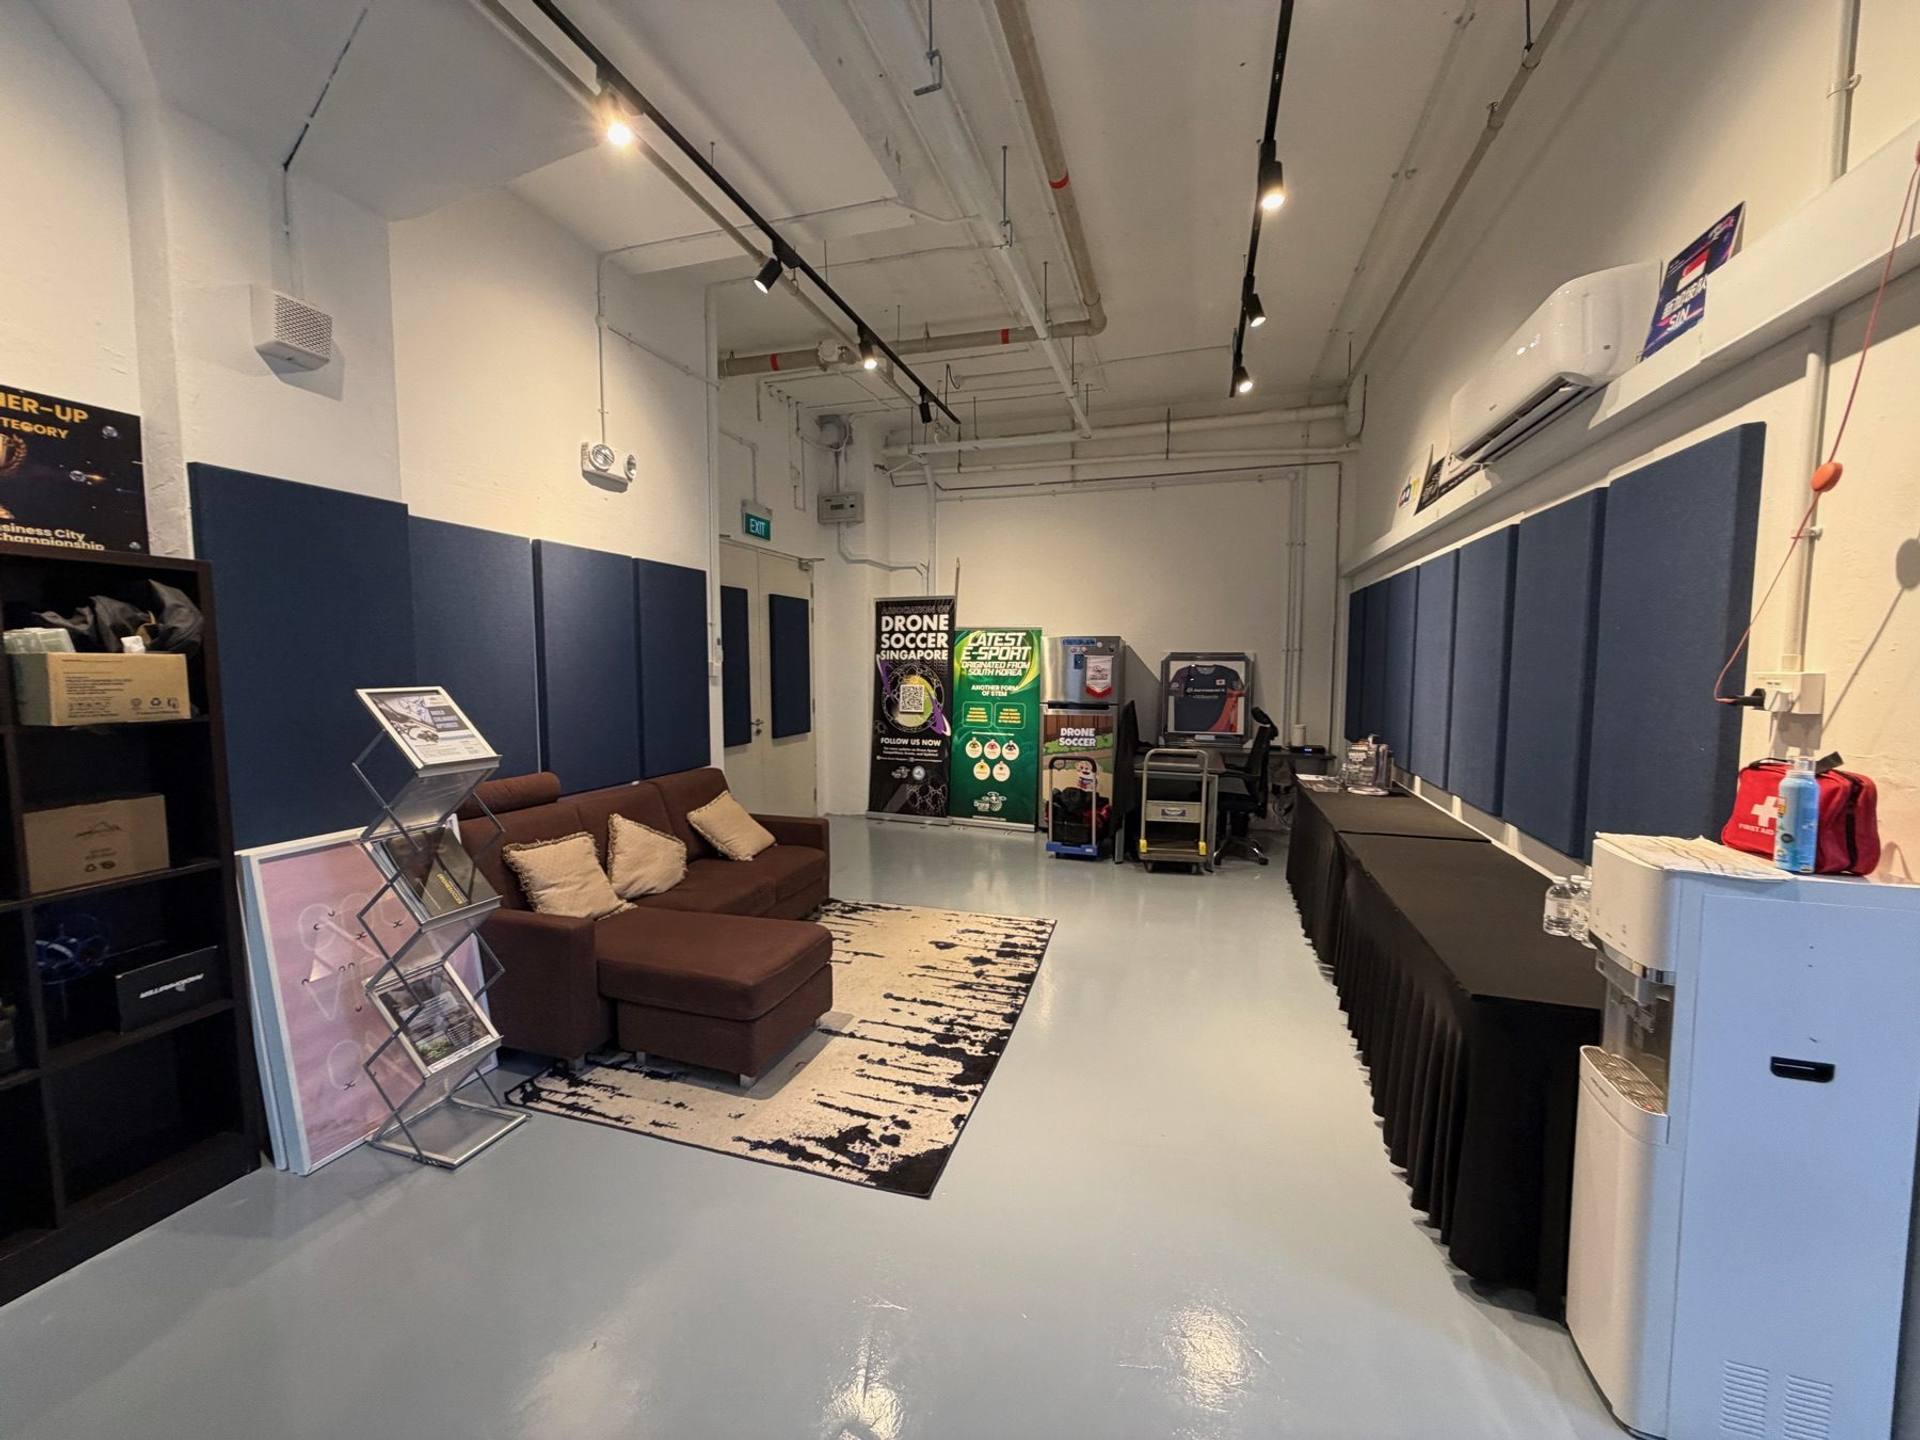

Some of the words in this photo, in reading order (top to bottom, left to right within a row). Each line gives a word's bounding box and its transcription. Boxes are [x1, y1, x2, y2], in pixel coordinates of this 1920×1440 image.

[1667, 304, 1691, 331] SIN
[0, 522, 52, 537] siness
[54, 529, 85, 542] City
[749, 518, 765, 536] EXIT
[881, 614, 949, 632] DRONE
[880, 632, 949, 649] SOCCER
[967, 632, 1026, 647] LATEST
[880, 649, 948, 660] SINGAPORE
[961, 647, 1032, 660] E-SPORT
[961, 661, 1005, 669] ORIGINATED
[968, 668, 995, 676] SOUTH
[1060, 727, 1095, 737] DRONE
[880, 737, 909, 745] FOLLOW
[921, 739, 942, 747] NOW
[1059, 737, 1096, 747] SOCCER
[1738, 823, 1760, 832] FIRST
